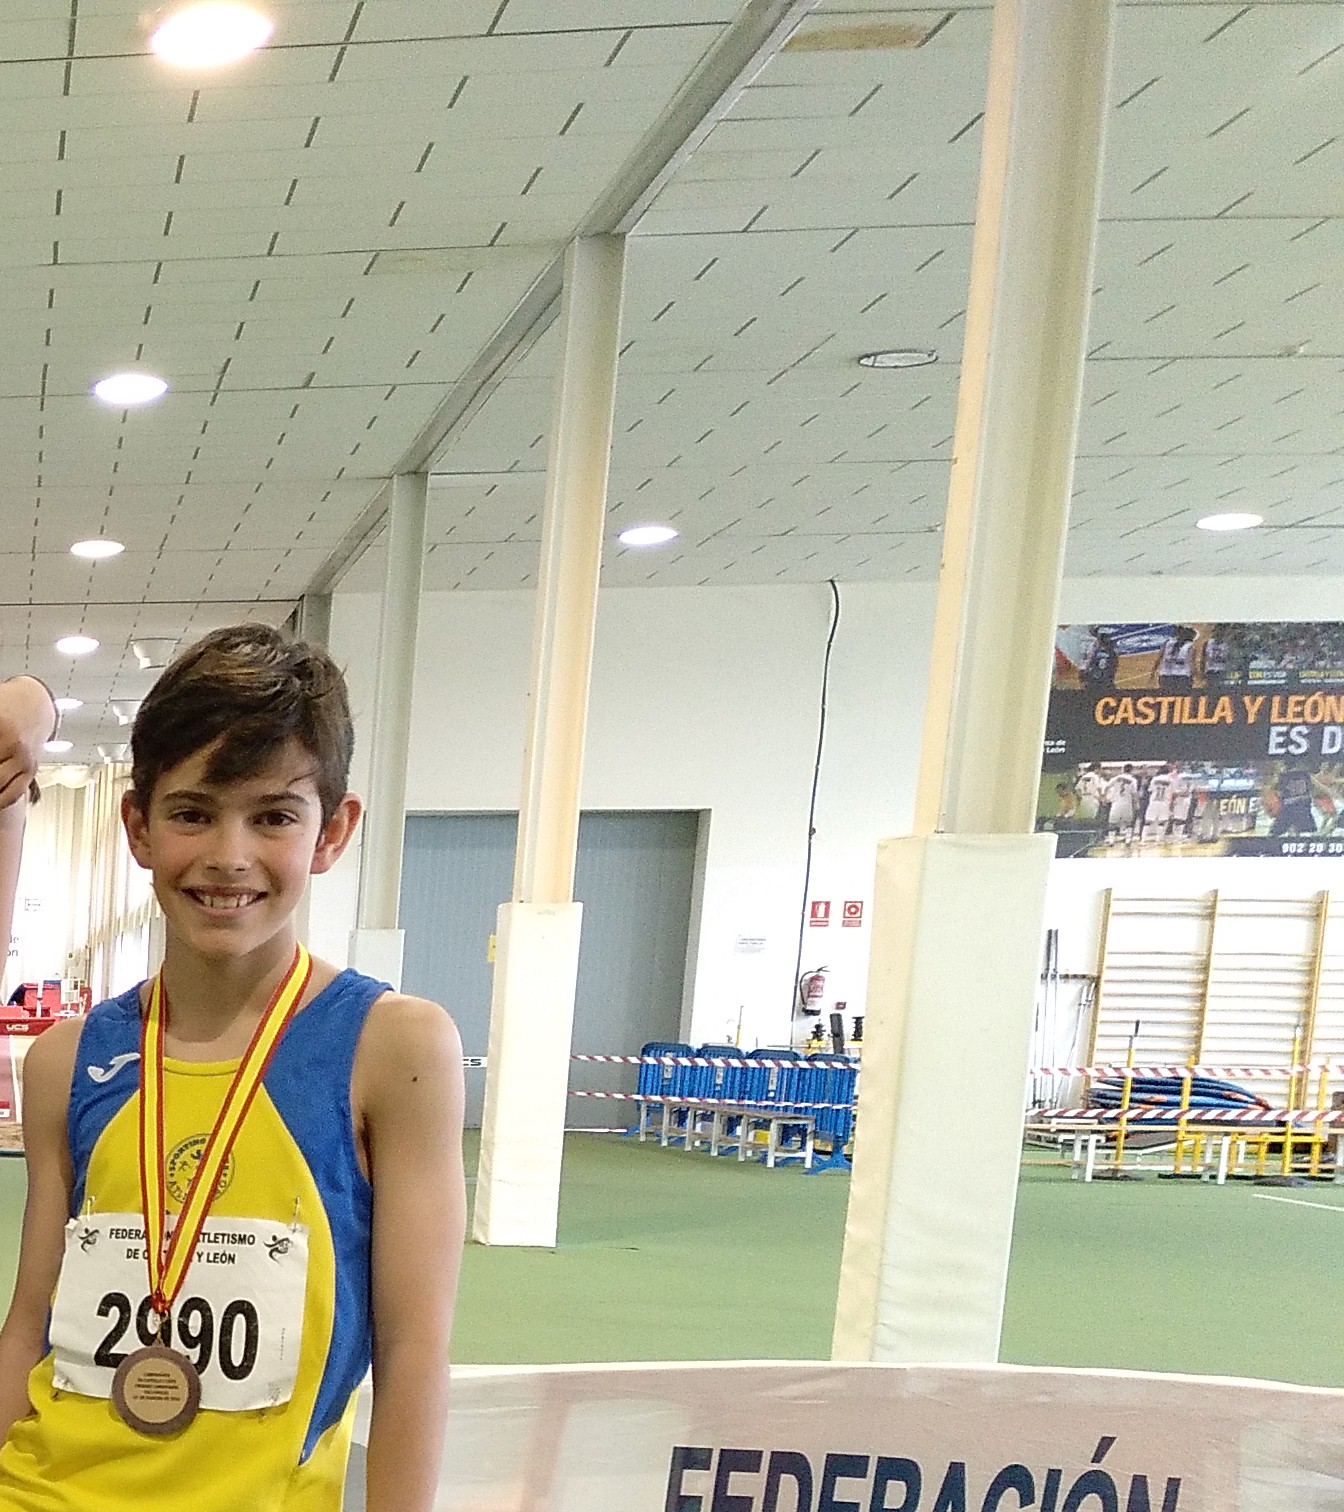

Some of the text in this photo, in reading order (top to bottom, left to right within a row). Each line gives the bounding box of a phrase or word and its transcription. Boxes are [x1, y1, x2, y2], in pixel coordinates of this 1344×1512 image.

[1095, 692, 1344, 725] CASTILLA Y LEÓN
[1268, 725, 1309, 756] ES
[169, 1138, 207, 1171] SPORTING
[126, 1248, 236, 1264] DE Y LEÓN
[93, 1291, 259, 1382] 2990
